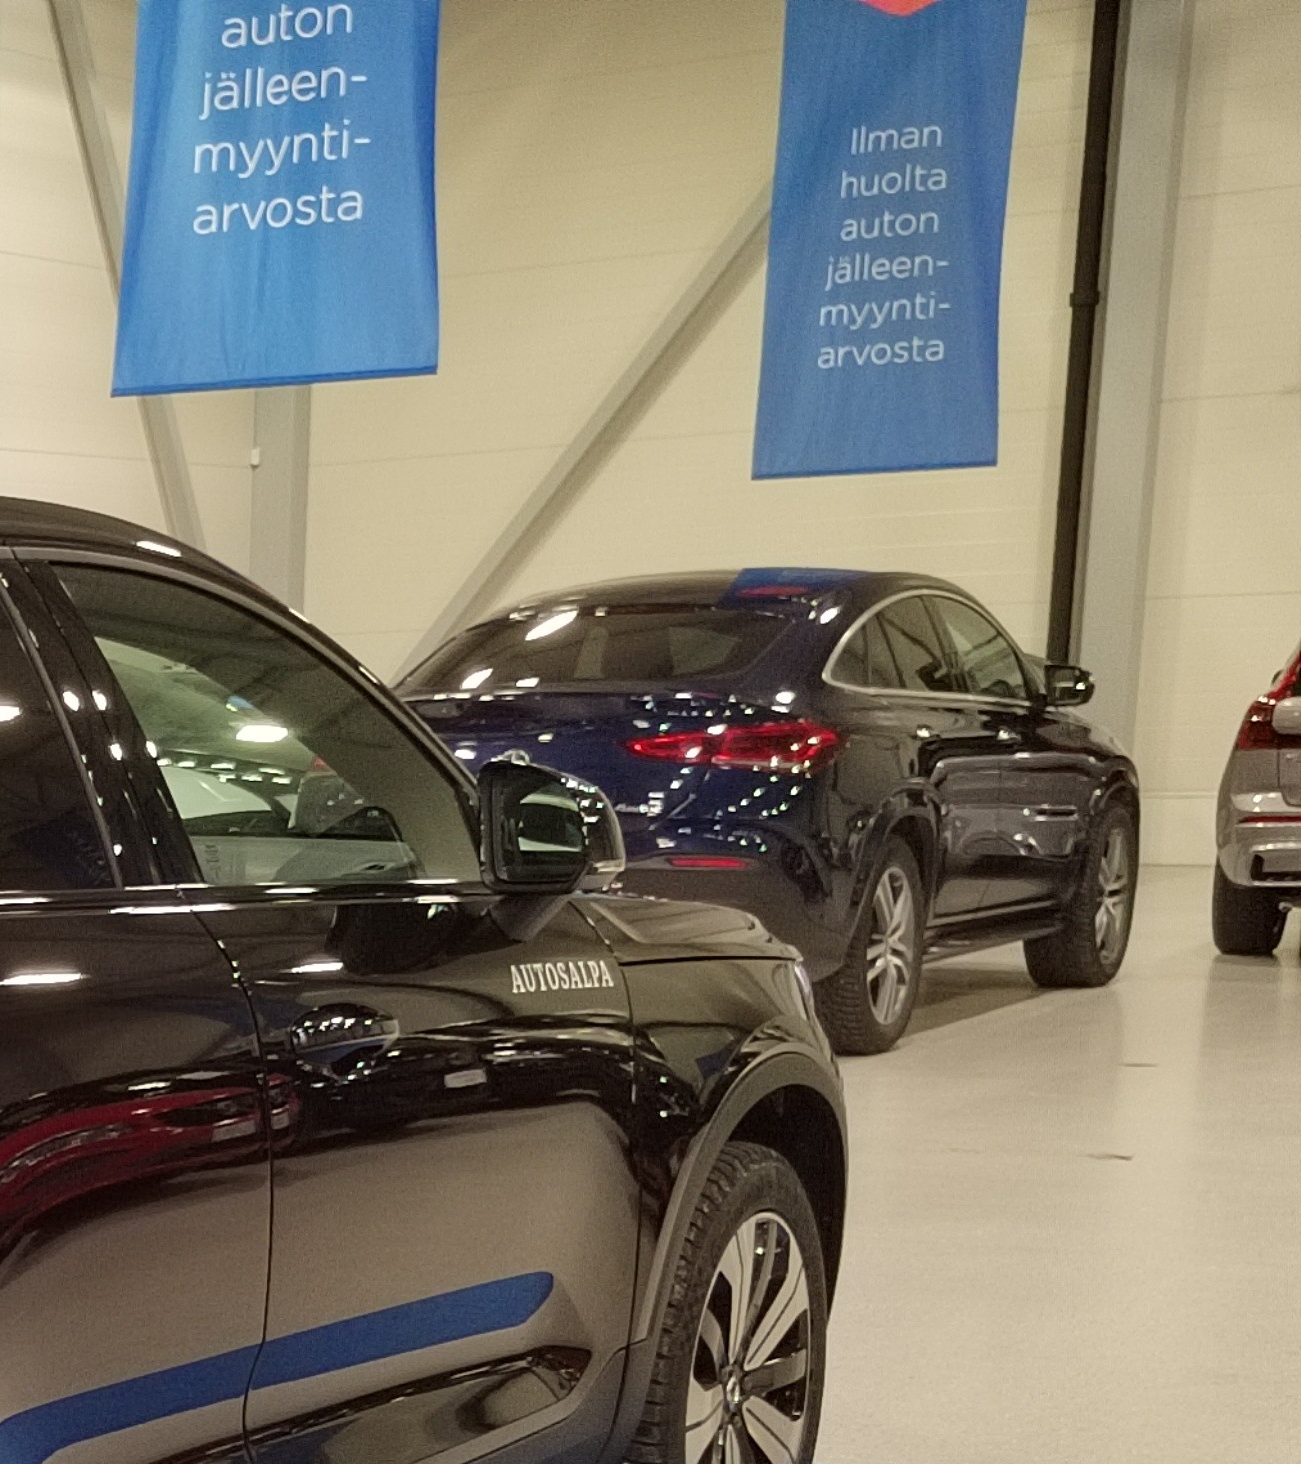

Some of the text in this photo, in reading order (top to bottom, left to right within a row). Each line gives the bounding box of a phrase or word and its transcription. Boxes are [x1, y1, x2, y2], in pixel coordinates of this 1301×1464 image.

[222, 4, 352, 48] auton
[199, 66, 368, 119] jälleen-
[193, 119, 371, 178] myynti-
[850, 125, 942, 154] Ilman
[840, 164, 948, 198] huolta
[193, 186, 363, 235] arvosta
[840, 210, 939, 241] auton
[824, 254, 949, 291] jälleen-
[819, 294, 950, 330] myynti-
[817, 336, 945, 369] arvosta
[510, 960, 614, 993] AUTOSALPA
